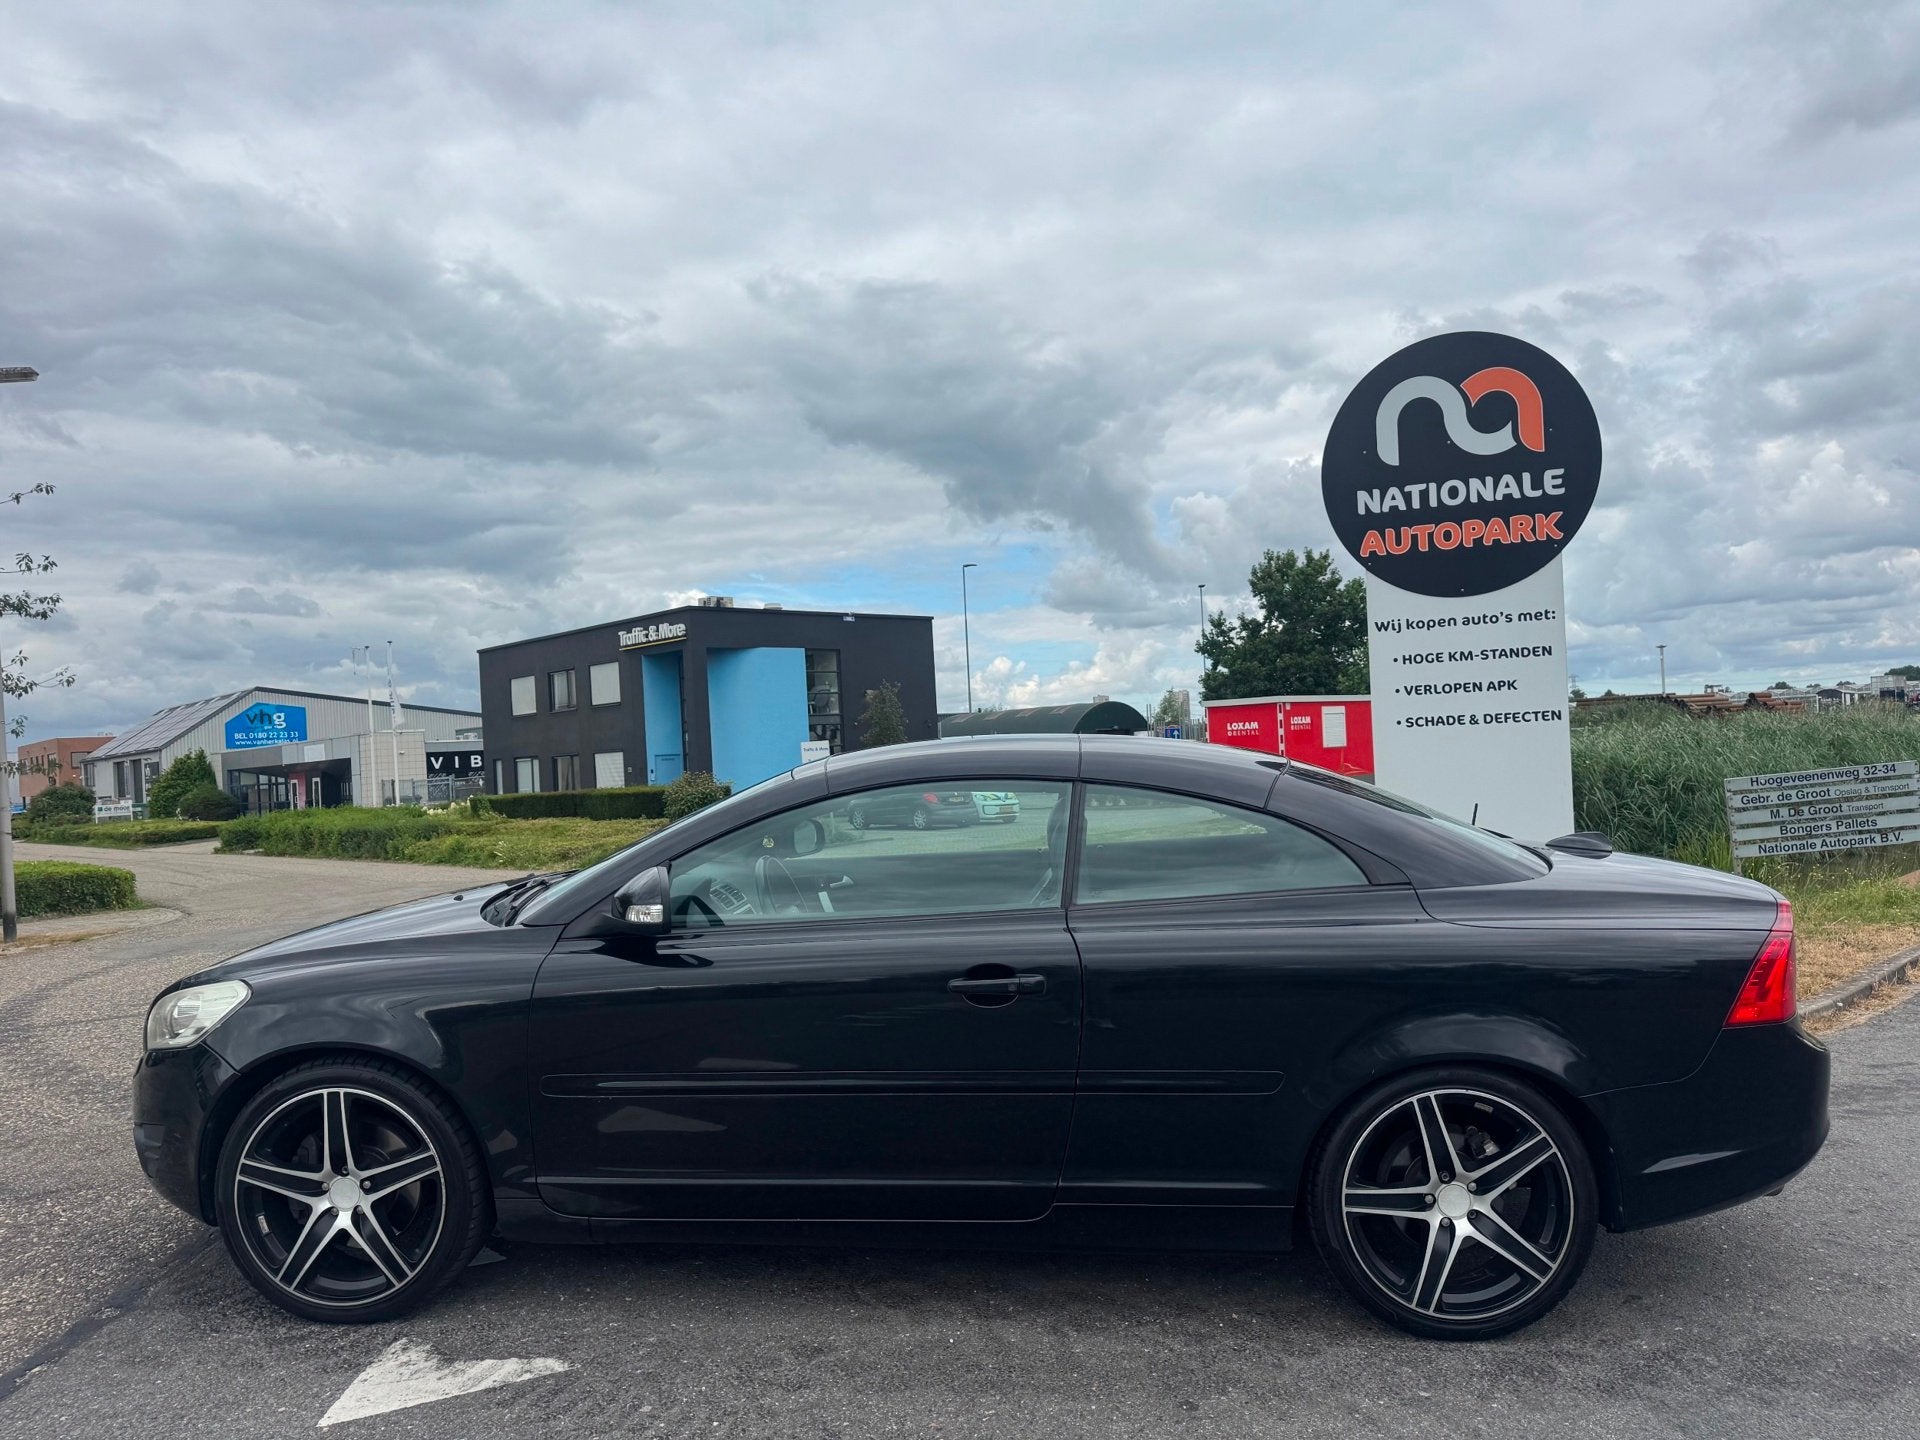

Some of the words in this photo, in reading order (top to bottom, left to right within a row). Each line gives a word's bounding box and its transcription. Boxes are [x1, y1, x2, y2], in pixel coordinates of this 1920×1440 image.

[1357, 468, 1565, 514] NATIONALE
[1360, 511, 1564, 557] AUTOPARK
[1374, 618, 1402, 634] Wij
[1406, 615, 1457, 631] kopen
[1461, 611, 1513, 626] auto's
[1518, 608, 1556, 622] met:
[618, 627, 648, 646] Traffic
[648, 625, 659, 641] &
[658, 622, 686, 640] More
[1402, 652, 1444, 665] HOGE
[1448, 645, 1553, 662] KM-STANDEN
[1404, 681, 1483, 696] VERLOPEN
[1486, 679, 1518, 692] APK
[245, 708, 287, 729] vhg
[1227, 722, 1259, 730] LOXAM
[1290, 716, 1311, 724] LOXAM
[1405, 714, 1466, 728] SCHADE
[1469, 714, 1480, 726] &
[1483, 710, 1562, 725] DEFECTEN
[1863, 763, 1896, 776] 32-34
[1741, 793, 1774, 806] Gebr.
[1777, 791, 1792, 802] de
[1795, 787, 1831, 800] Groot
[1834, 788, 1862, 799] Opslag
[1864, 785, 1870, 793] &
[1872, 782, 1910, 794] Transport
[1770, 809, 1785, 820] M.
[1788, 806, 1804, 817] De
[1808, 803, 1844, 816] Groot
[1848, 802, 1884, 813] Transport
[1779, 822, 1832, 836] Bongers
[1836, 818, 1878, 830] Pallets
[1758, 840, 1817, 855] Nationale
[1820, 834, 1876, 849] Autopark
[1880, 831, 1904, 843] B.V.
